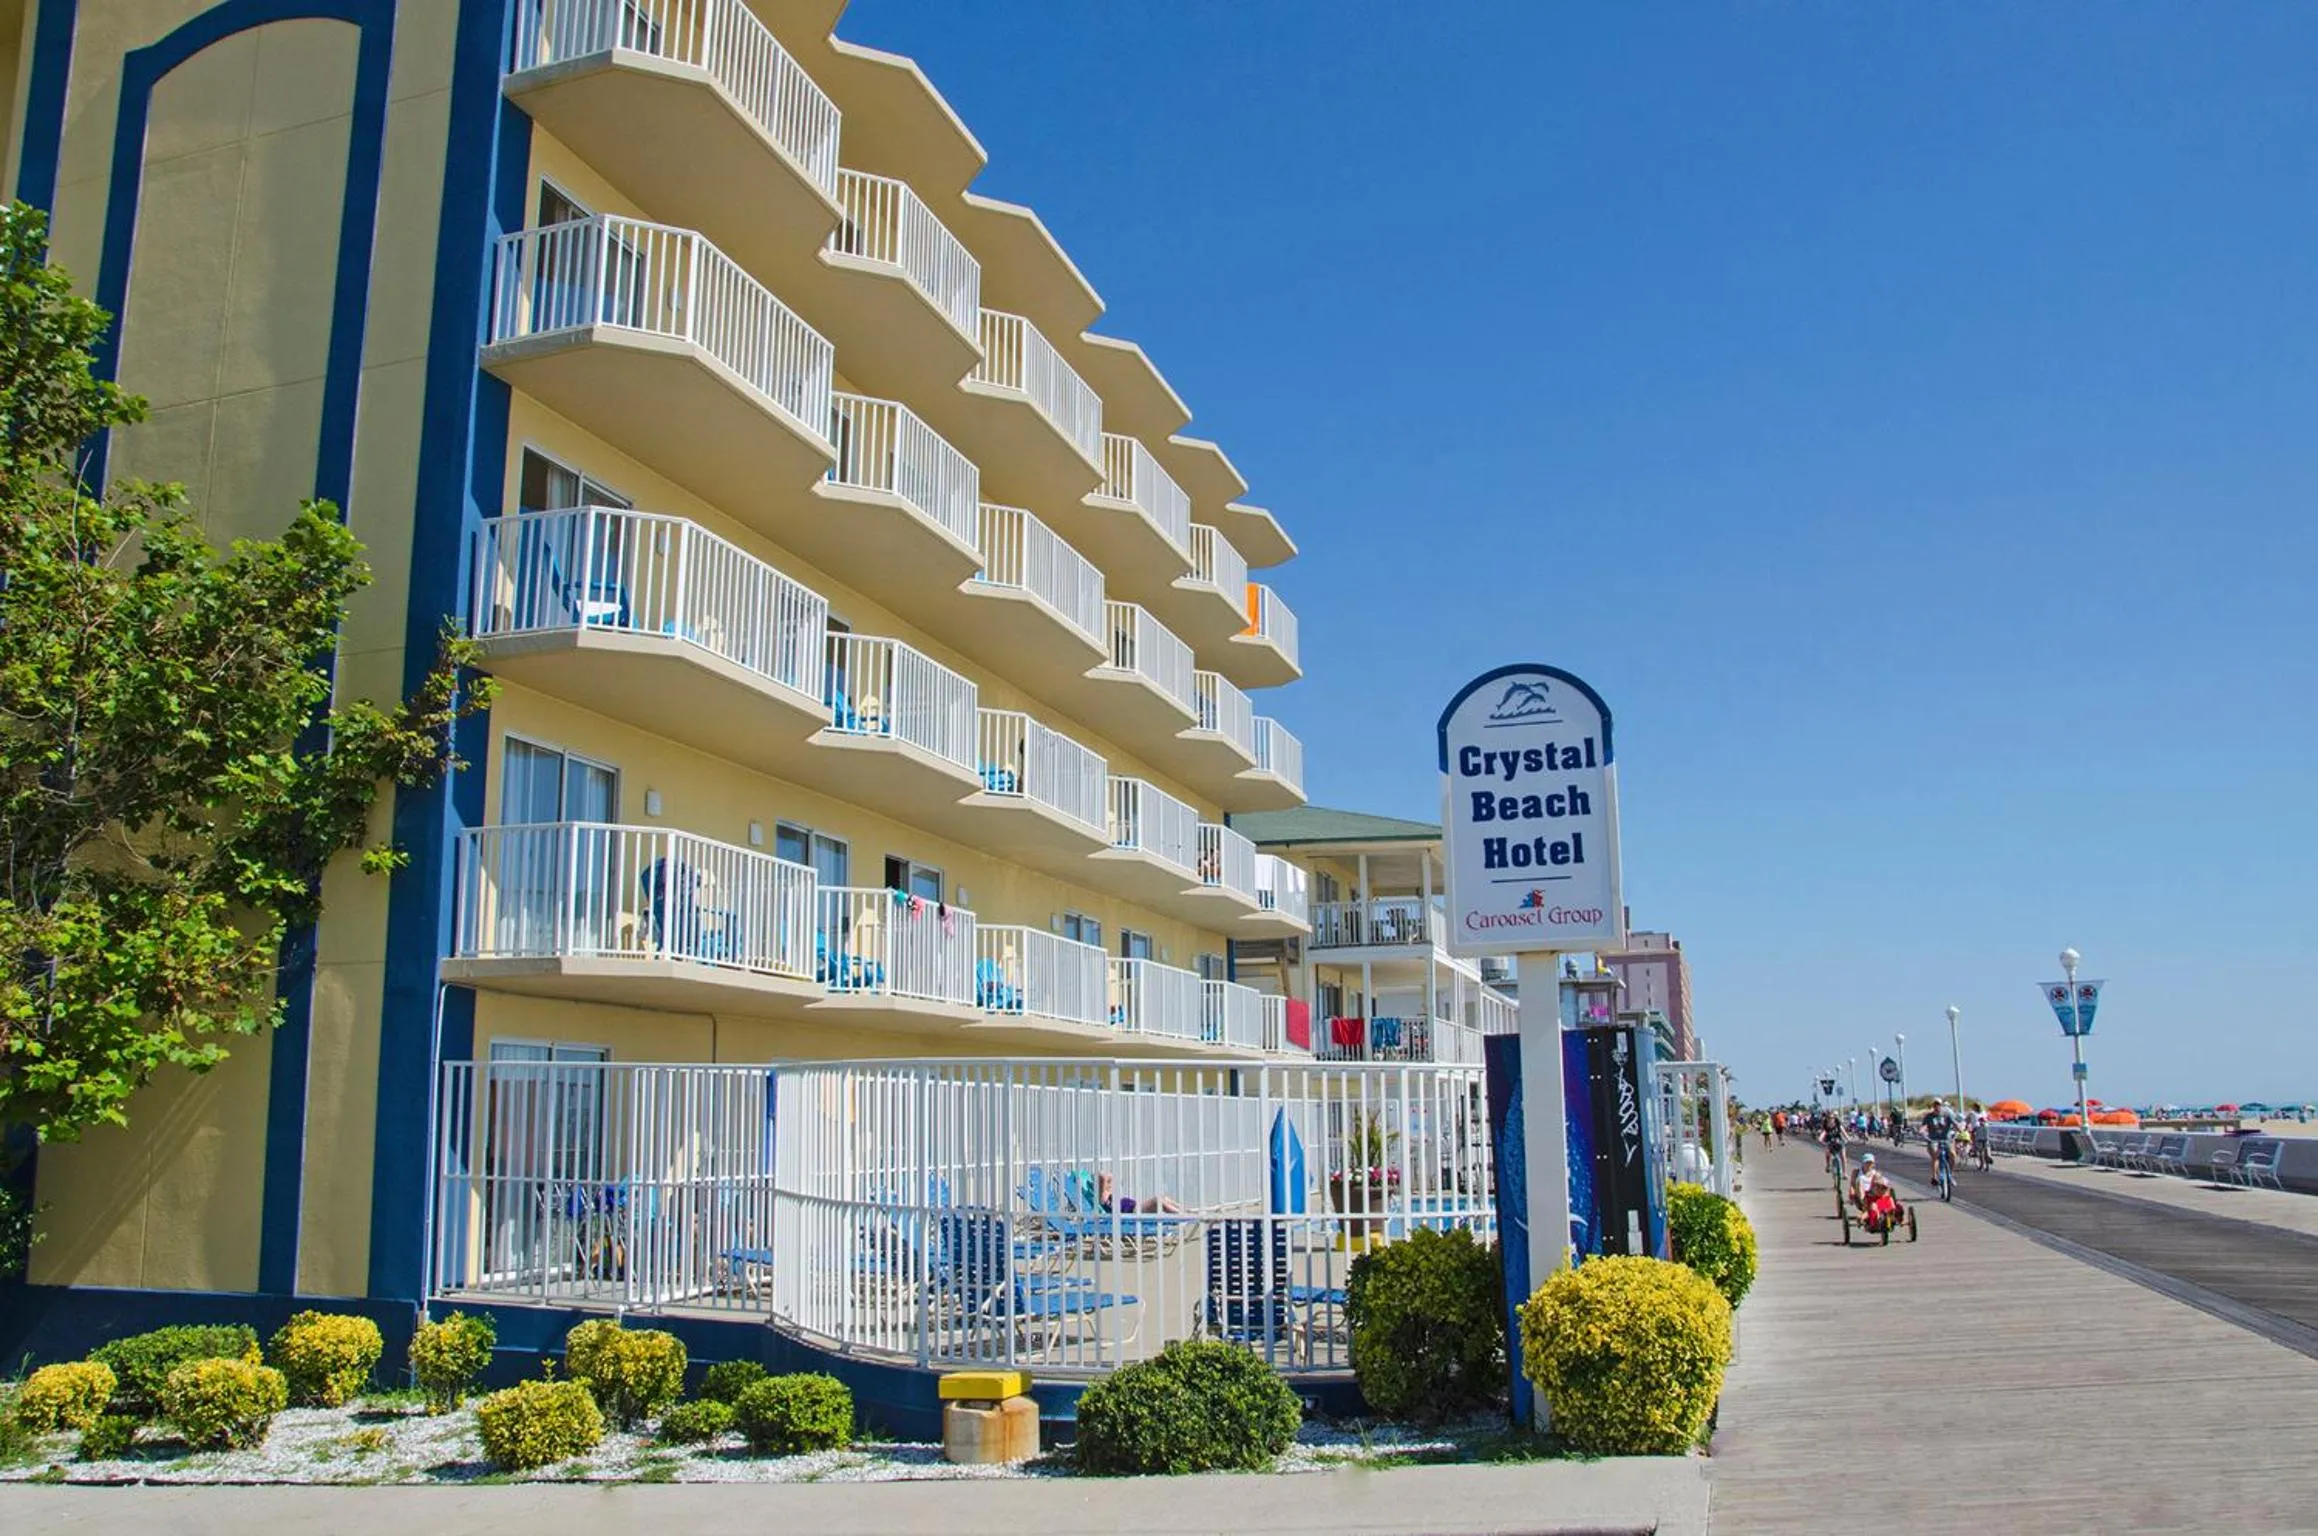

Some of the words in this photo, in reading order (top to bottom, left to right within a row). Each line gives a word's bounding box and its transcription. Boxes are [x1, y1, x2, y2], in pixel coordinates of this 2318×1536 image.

[1459, 736, 1597, 782] Crystal
[1471, 784, 1591, 822] Beach
[1483, 832, 1585, 869] Hotel
[1465, 909, 1543, 931] Carousel
[1548, 906, 1604, 927] Group
